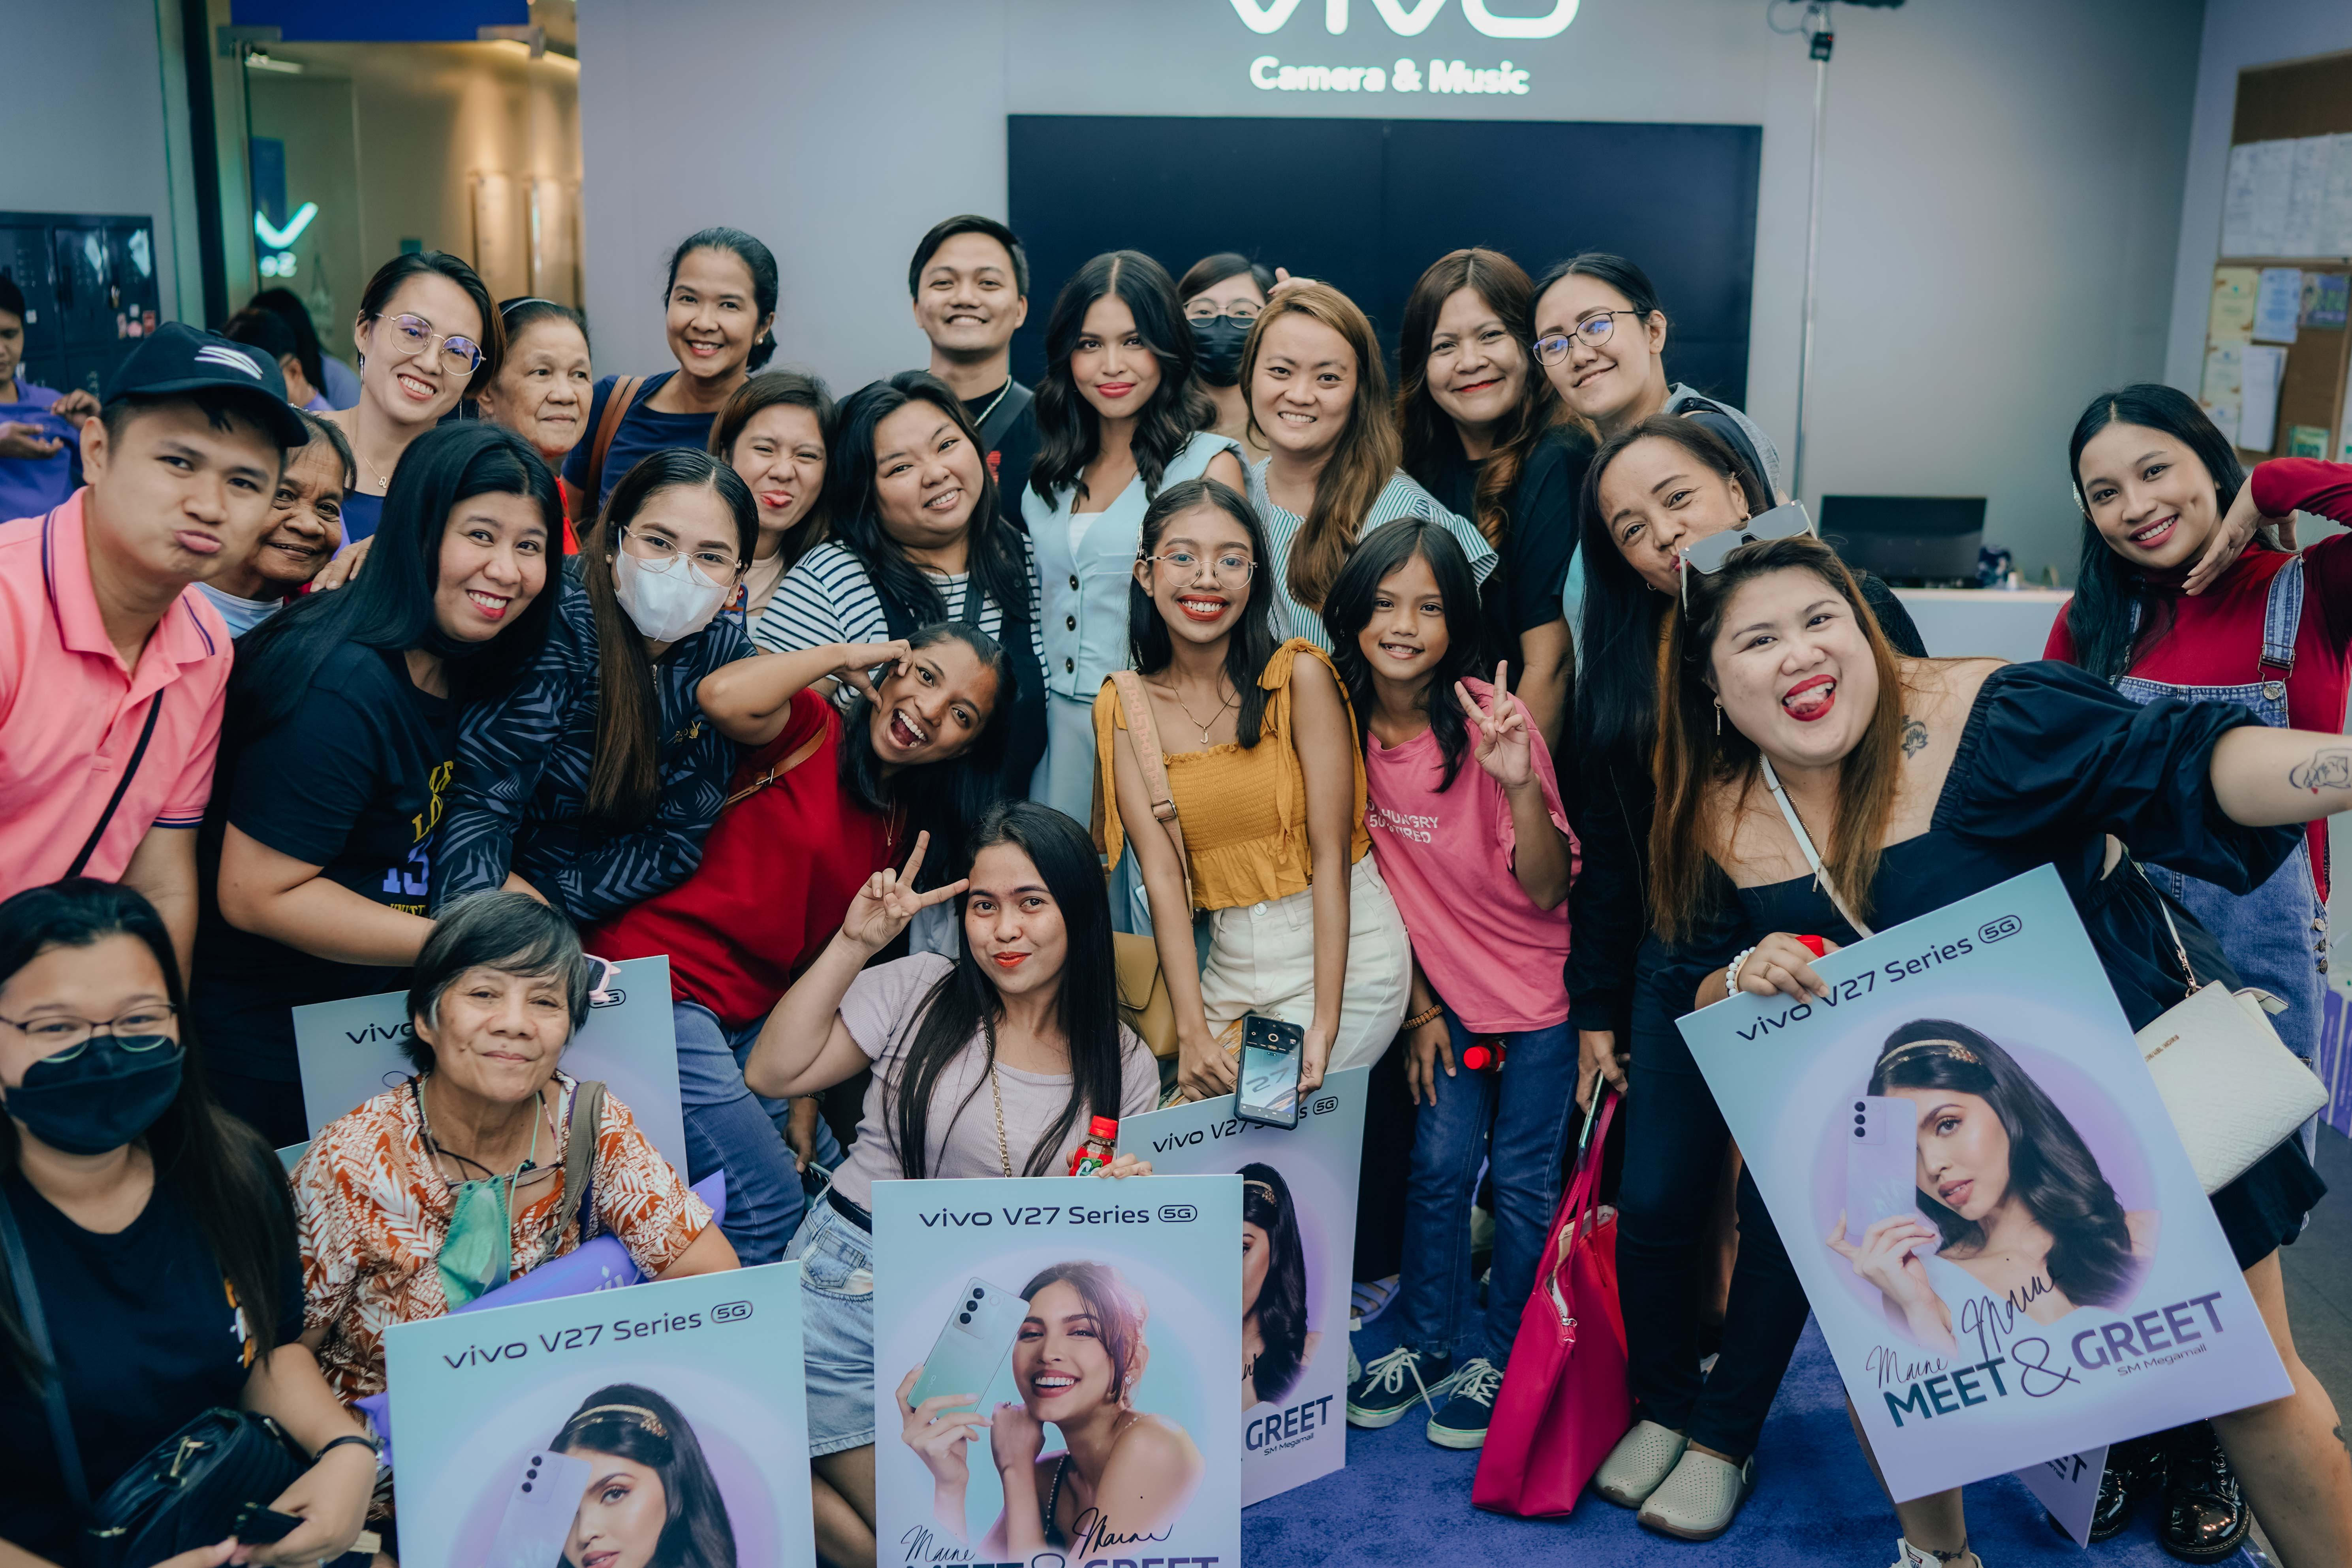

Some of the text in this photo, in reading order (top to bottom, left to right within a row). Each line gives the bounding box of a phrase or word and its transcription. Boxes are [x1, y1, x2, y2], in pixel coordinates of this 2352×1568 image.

[1250, 56, 1530, 95] Camera & Music
[1393, 825, 1431, 844] TIRED
[594, 993, 619, 1005] G
[1736, 919, 2015, 1040] vivo V27 Series 5G
[1152, 1130, 1204, 1153] vivo
[1316, 1100, 1334, 1111] 5G
[919, 1205, 1191, 1227] vivo V27 Series 5G
[443, 1305, 746, 1369] vivo V27 Series 5G
[1883, 1291, 2224, 1428] MEET & GREET
[2117, 1344, 2207, 1376] SM Megamall
[1246, 1394, 1333, 1451] GREET
[1264, 1432, 1314, 1456] SM Megamall
